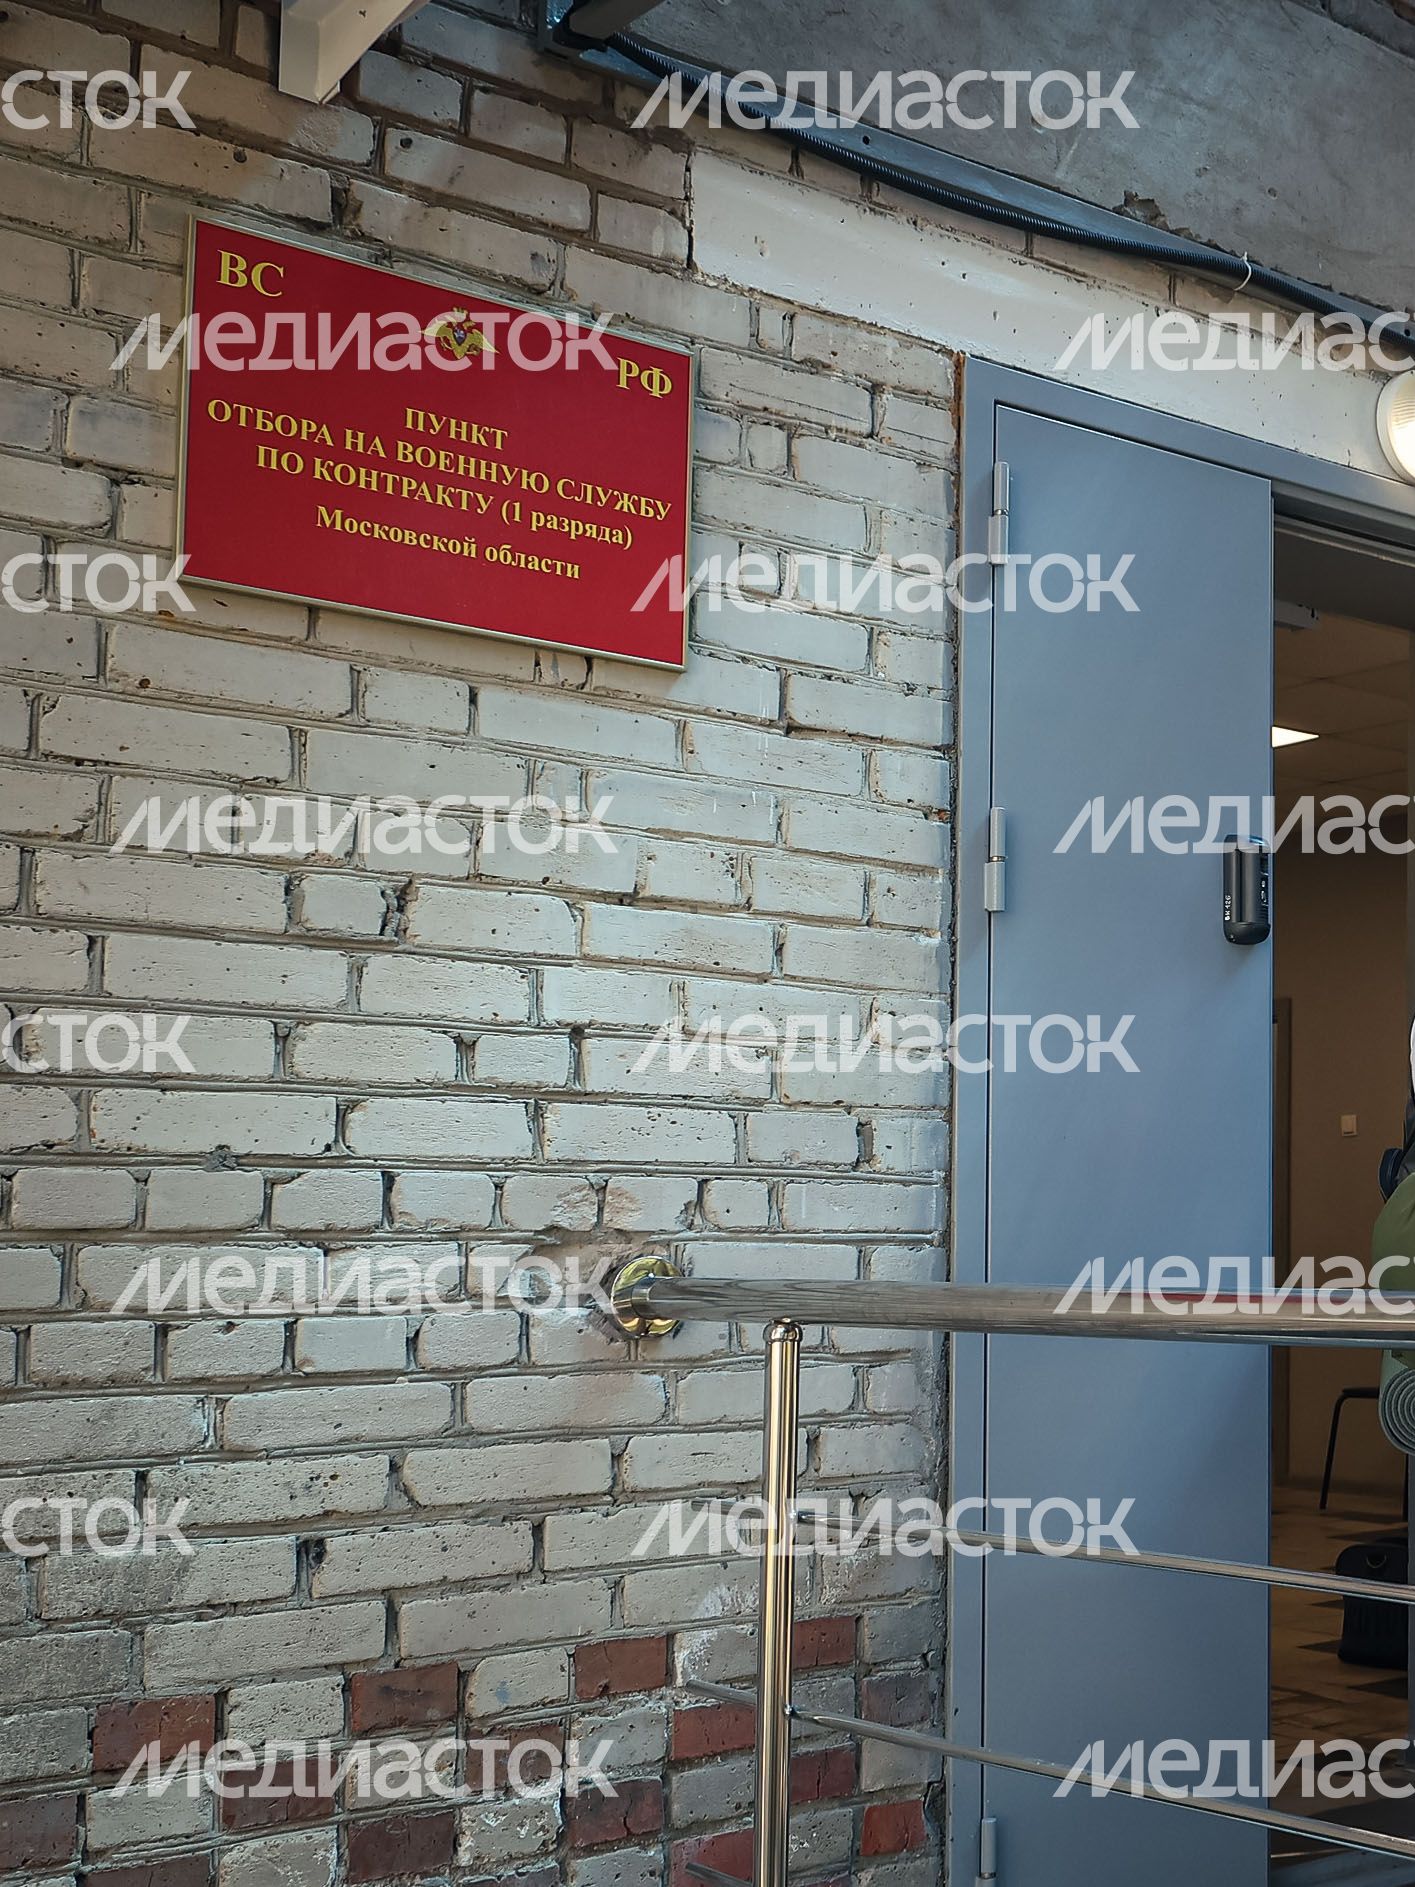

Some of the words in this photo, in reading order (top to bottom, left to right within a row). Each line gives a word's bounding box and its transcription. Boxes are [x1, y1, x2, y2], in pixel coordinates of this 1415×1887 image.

[216, 249, 285, 298] ВС
[616, 356, 674, 400] РФ
[403, 407, 510, 450] ПУНКТ
[207, 398, 335, 447] ОТБОРА
[344, 428, 387, 459] НА
[396, 440, 550, 494] ВОЕННУЮ
[556, 478, 673, 522] СЛУЖБУ
[255, 444, 305, 475] ПО
[312, 458, 495, 516] КОНТРАКТУ
[501, 499, 522, 525] (1
[530, 510, 634, 551] разряда)
[315, 505, 478, 560] Московской
[485, 544, 581, 580] области
